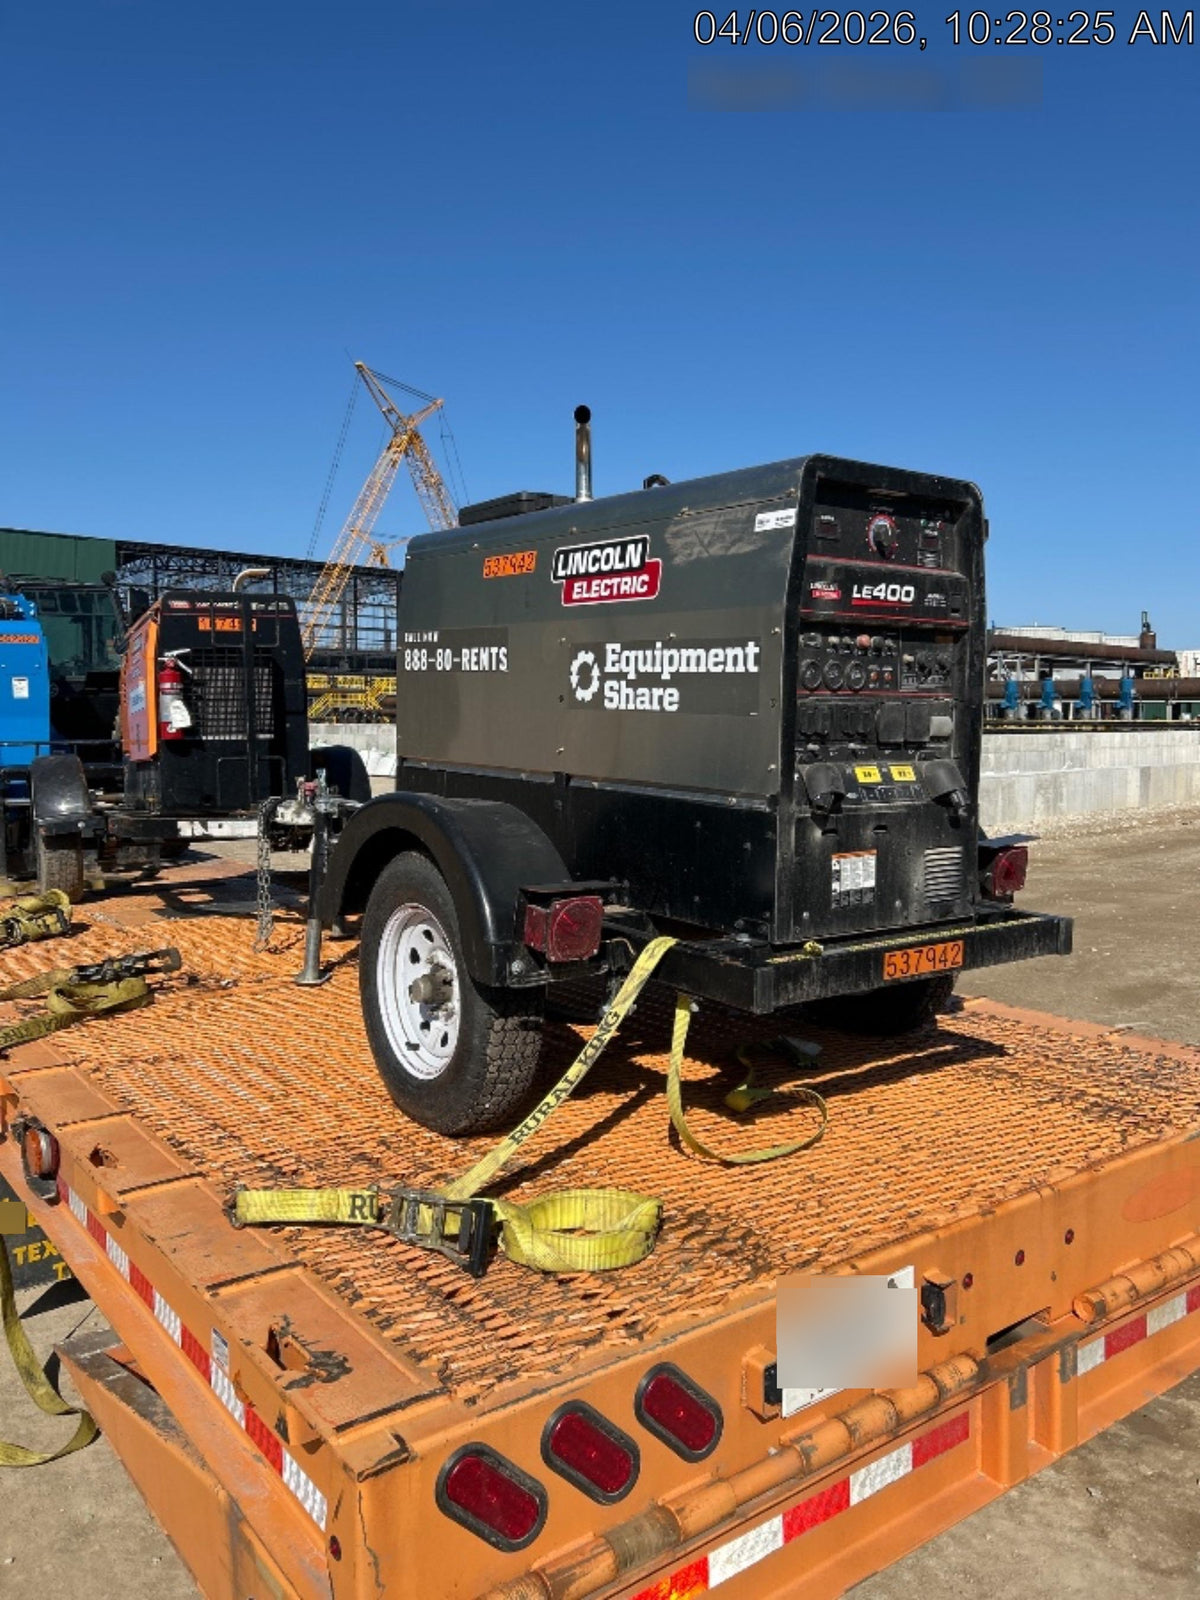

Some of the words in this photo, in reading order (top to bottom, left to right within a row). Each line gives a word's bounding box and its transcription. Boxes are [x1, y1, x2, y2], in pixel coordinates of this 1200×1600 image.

[484, 552, 535, 577] 537942
[557, 541, 643, 577] LINCOLN
[572, 574, 650, 600] ELECTRIC
[852, 583, 915, 603] LE400
[404, 647, 508, 672] 888-80-RENTS
[604, 641, 760, 680] Equipment
[604, 680, 680, 711] Share
[886, 943, 963, 978] 537942
[508, 1075, 580, 1145] RURAL
[577, 1010, 620, 1066] KING
